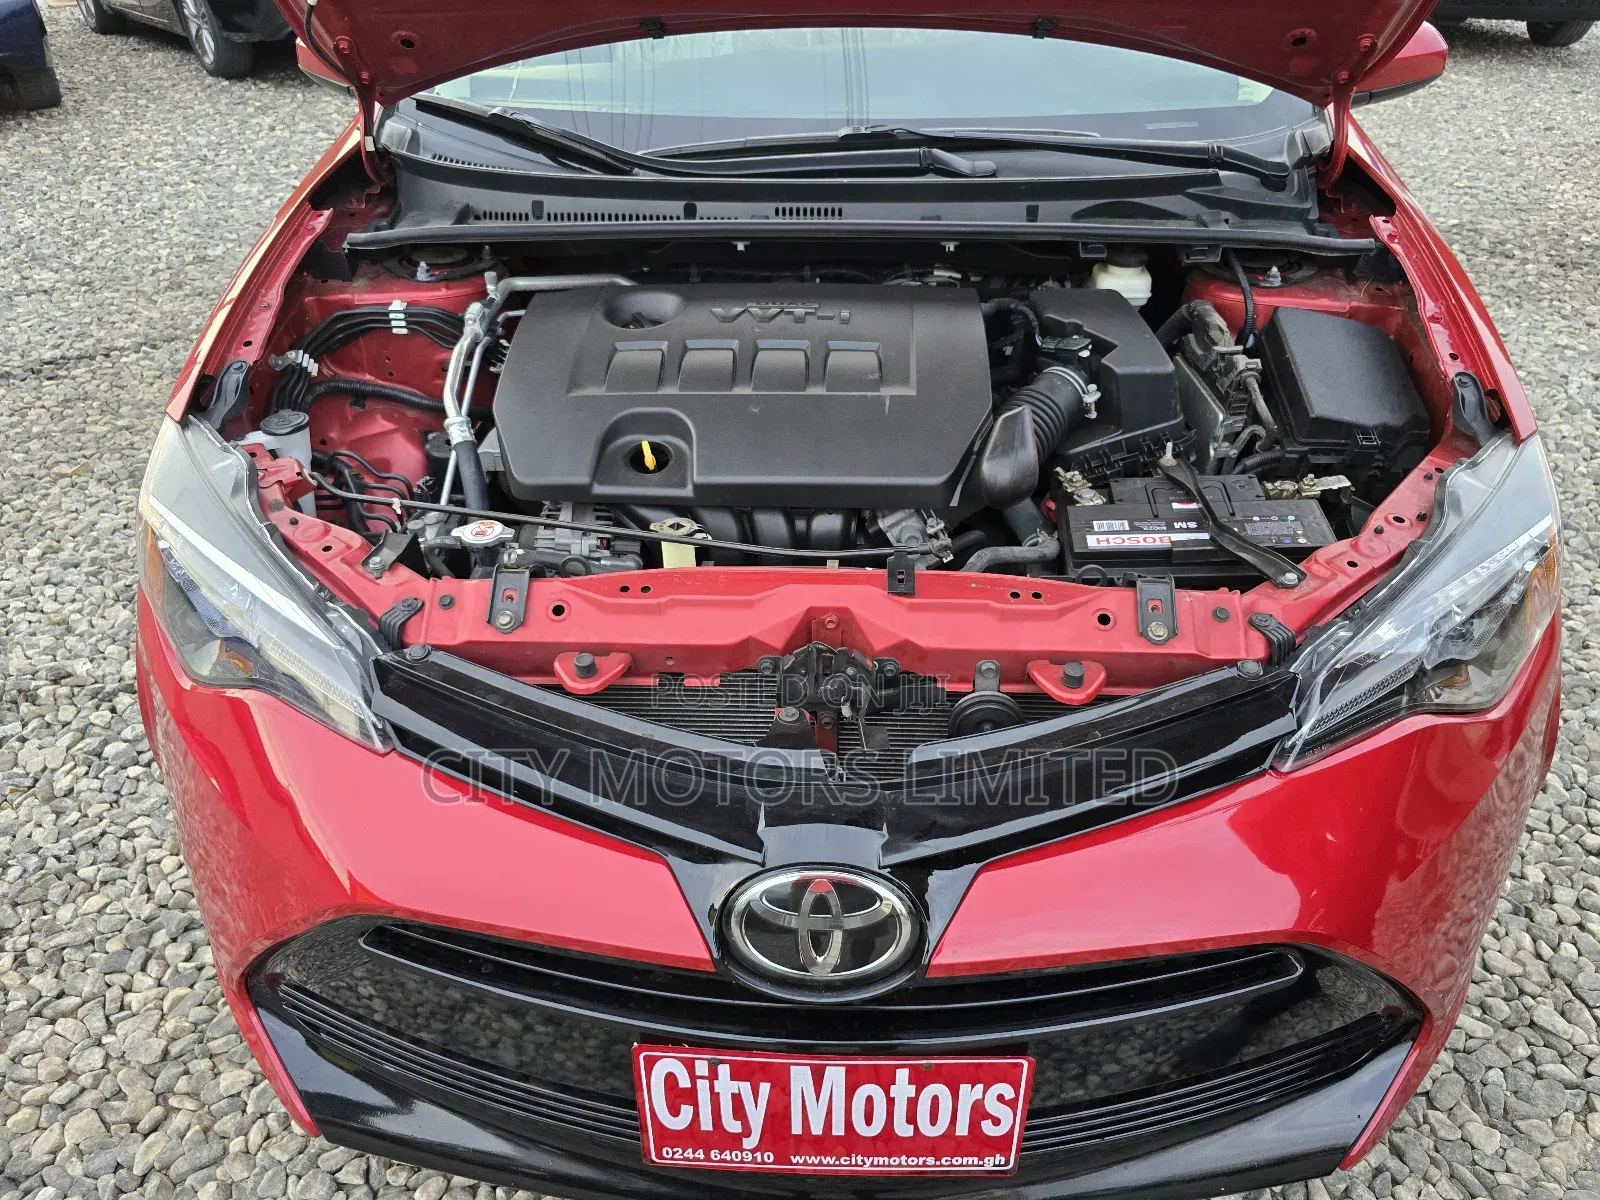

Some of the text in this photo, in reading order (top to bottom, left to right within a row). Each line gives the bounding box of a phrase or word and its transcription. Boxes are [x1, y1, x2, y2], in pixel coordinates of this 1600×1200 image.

[1173, 521, 1198, 530] SM
[1095, 535, 1172, 546] BOSCH
[650, 1057, 1015, 1150] City Motors
[662, 1147, 1005, 1168] 0244 640910 www.citymotors.com.gh
